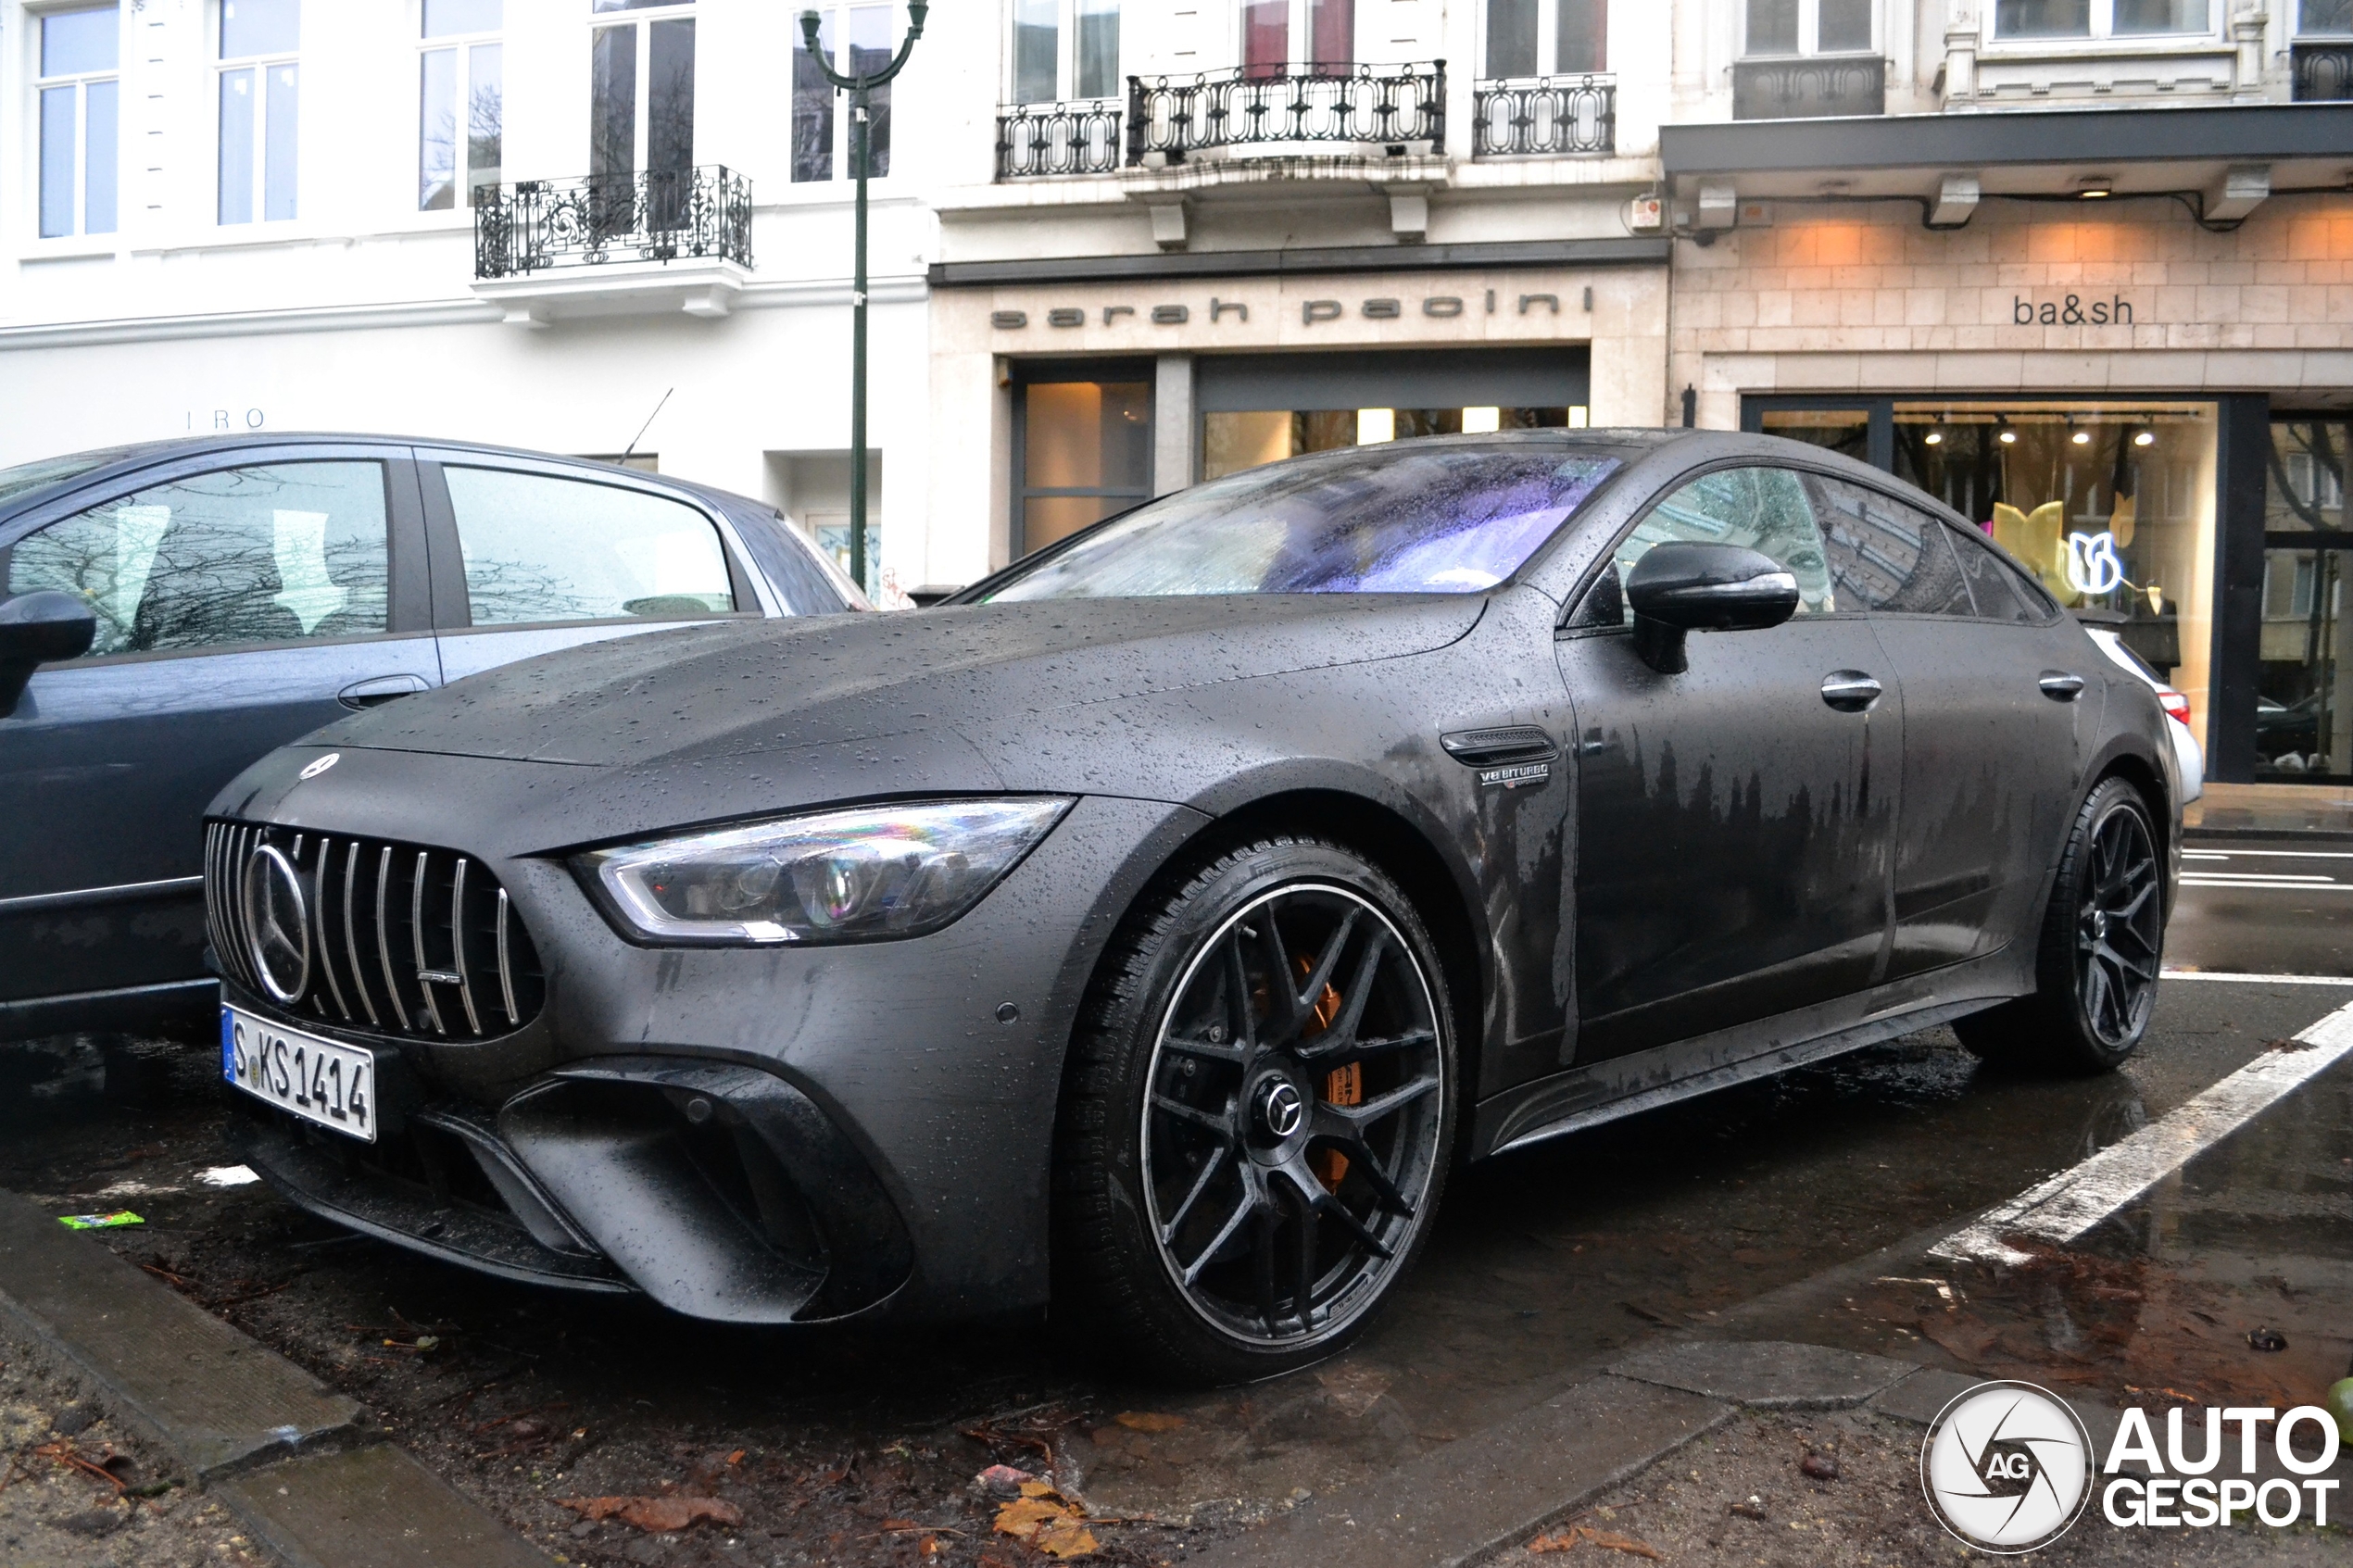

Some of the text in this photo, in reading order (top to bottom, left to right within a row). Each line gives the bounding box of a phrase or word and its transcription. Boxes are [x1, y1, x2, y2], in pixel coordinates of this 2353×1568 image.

[990, 297, 1249, 330] sarah
[2014, 294, 2133, 325] ba&sh
[187, 408, 264, 430] IRO
[1479, 763, 1548, 783] V8 BITURBO
